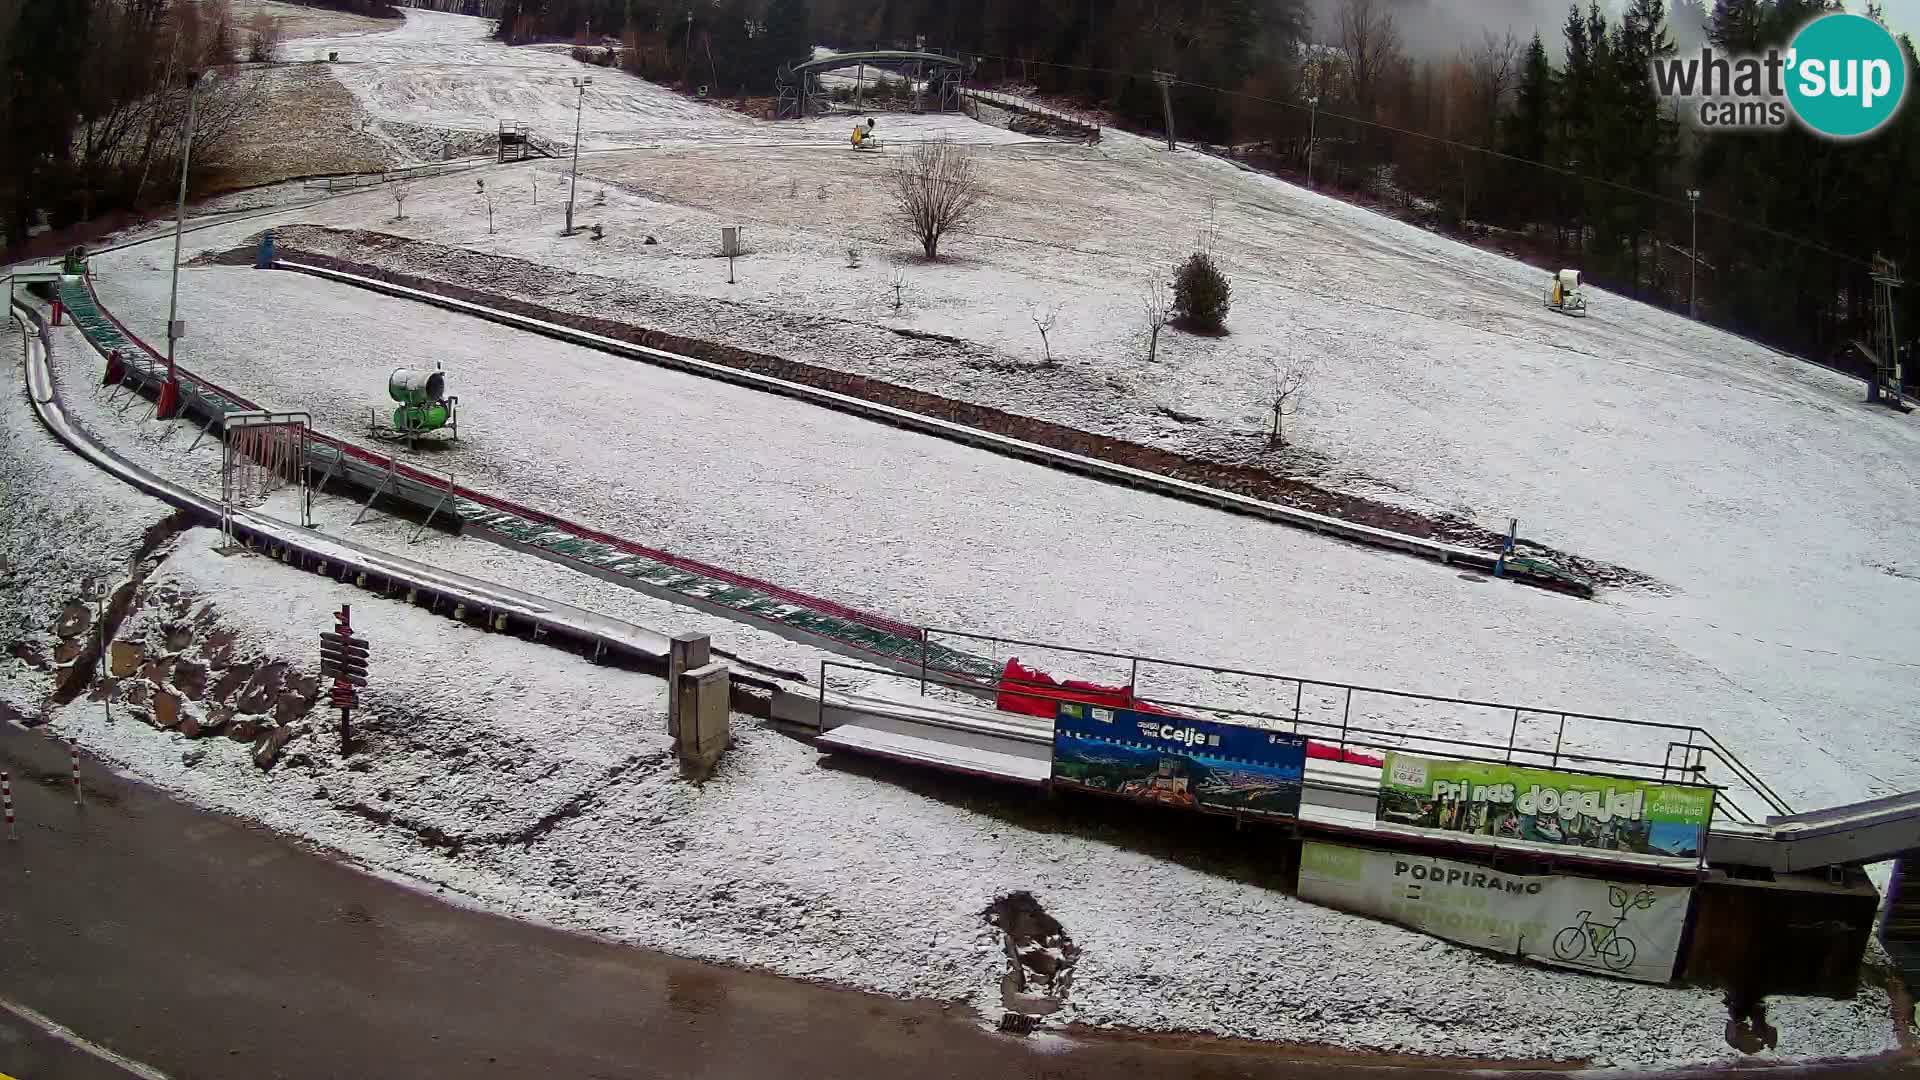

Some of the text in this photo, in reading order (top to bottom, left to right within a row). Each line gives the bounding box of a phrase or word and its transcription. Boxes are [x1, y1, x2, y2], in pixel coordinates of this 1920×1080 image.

[1160, 724, 1206, 747] Celje
[1431, 779, 1469, 801] Pri
[1473, 783, 1515, 803] nas
[1516, 784, 1646, 823] dogaja!
[1394, 860, 1544, 895] PODPIRAMO
